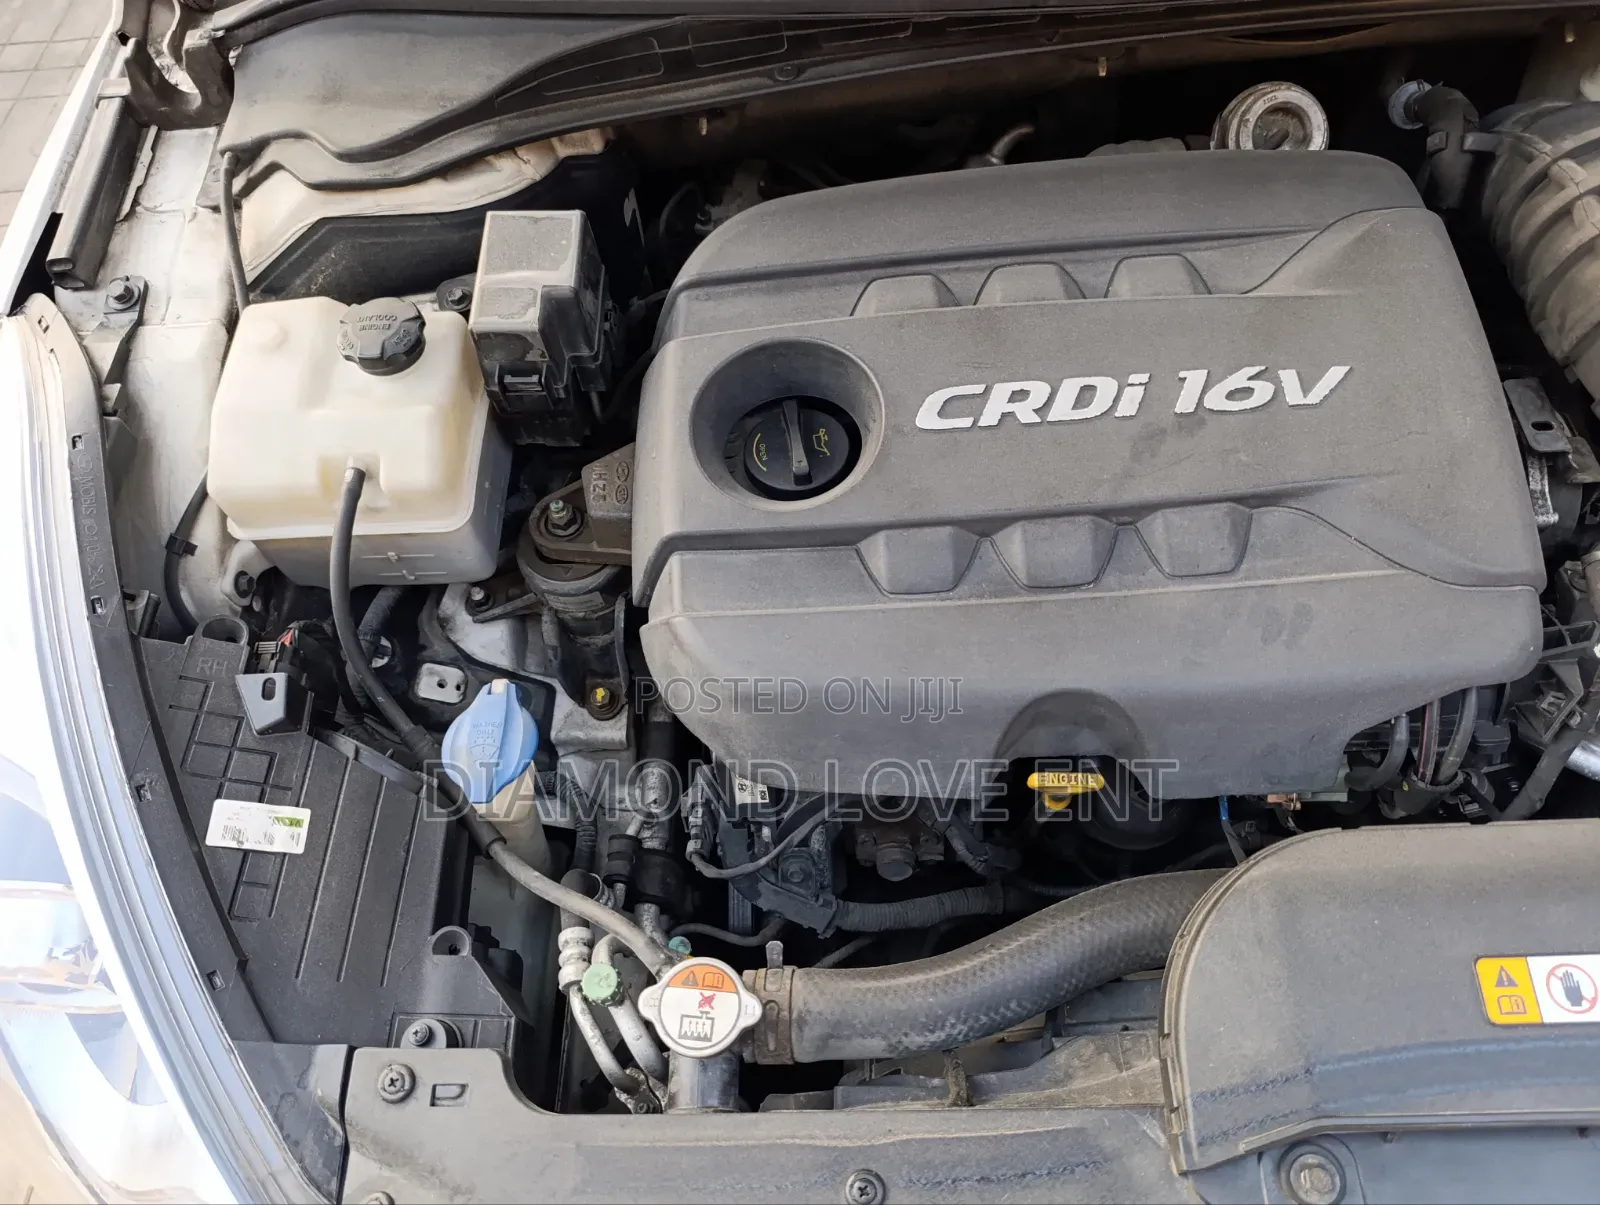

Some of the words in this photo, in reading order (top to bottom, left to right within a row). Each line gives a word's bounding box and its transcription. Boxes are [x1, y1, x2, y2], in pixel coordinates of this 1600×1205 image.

[359, 323, 391, 332] ENGINE
[915, 373, 1152, 430] CRDi
[1174, 365, 1352, 414] 16V
[759, 443, 768, 461] OPEN
[79, 476, 97, 517] MOBIS
[196, 656, 228, 678] RH
[472, 720, 502, 728] WASHER
[476, 728, 495, 736] ONLY
[1039, 772, 1097, 786] ENGINE
